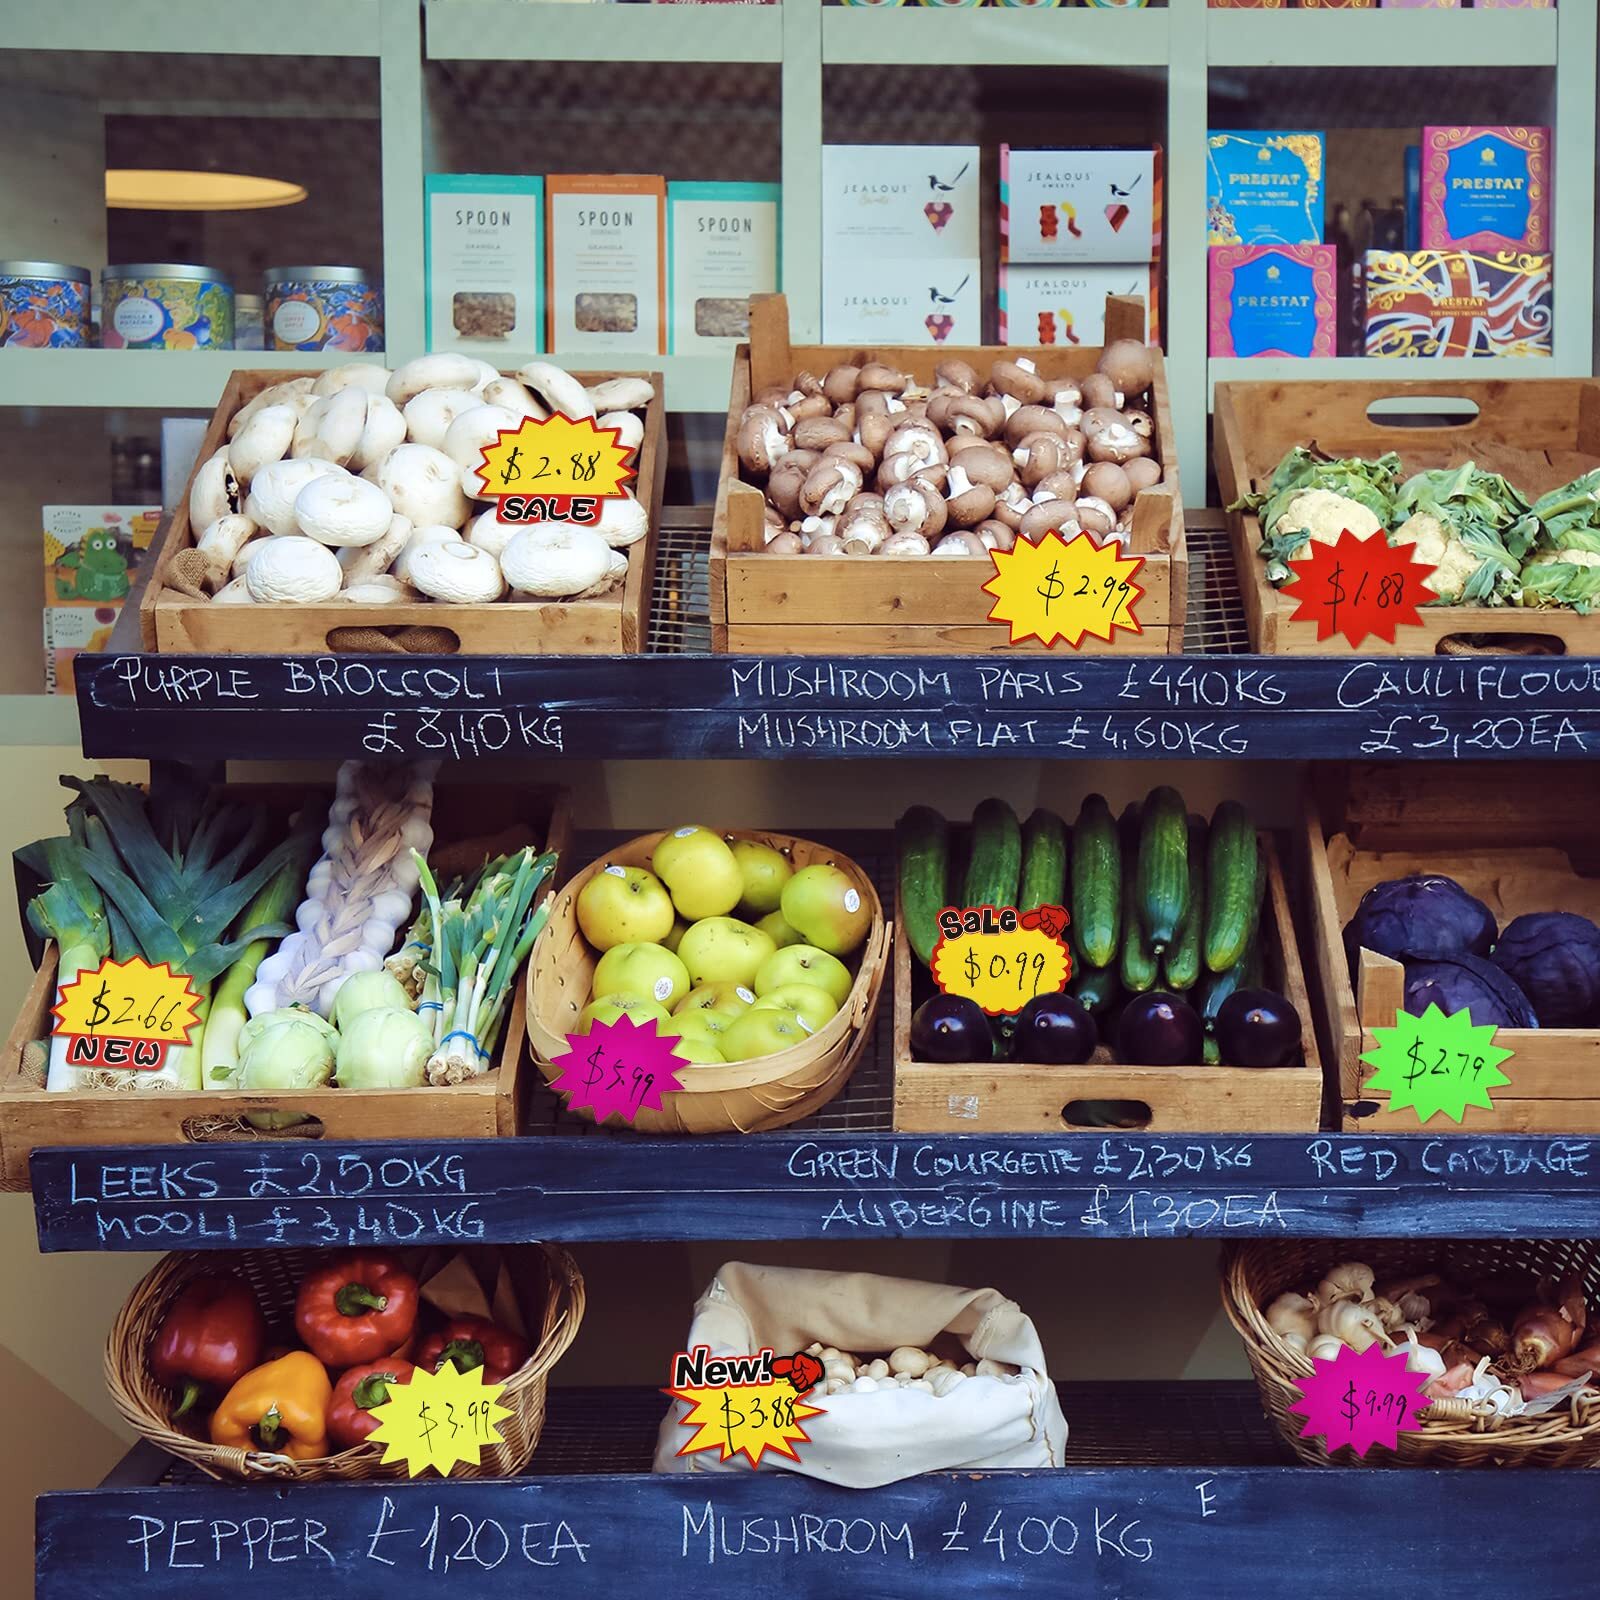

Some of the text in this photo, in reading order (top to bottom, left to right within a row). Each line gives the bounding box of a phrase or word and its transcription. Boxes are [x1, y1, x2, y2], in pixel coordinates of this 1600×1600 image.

[843, 184, 908, 194] JEALOUS
[1027, 172, 1091, 182] JEALOUS
[1229, 173, 1301, 186] PRESTAT
[1452, 177, 1524, 190] PRESTAT
[455, 209, 511, 226] SPOON
[577, 210, 633, 227] SPOON
[697, 216, 752, 233] SPOON
[843, 296, 908, 306] JEALOUS
[1025, 279, 1088, 289] JEALOUS
[1238, 295, 1310, 308] PRESTAT
[1433, 297, 1485, 307] PRESTAT
[502, 497, 597, 521] SALE
[1036, 559, 1131, 622] $2.99
[1322, 561, 1405, 635] $1.88
[112, 656, 506, 704] PURPLE BROCCOLI
[731, 660, 952, 701] MUSHROOM
[975, 666, 1084, 702] PARIS
[737, 713, 934, 751] MUSHROOM
[947, 717, 1040, 749] FLAT
[964, 946, 1046, 998] $0.99
[85, 979, 182, 1041] $2.66
[73, 1037, 161, 1067] NEW
[1401, 1035, 1486, 1090] $2.79
[581, 1044, 656, 1106] $5.99
[786, 1146, 898, 1184] GREEN
[912, 1149, 1085, 1181] COURGETTE
[1305, 1138, 1592, 1181] RED CABBAGE
[71, 1159, 220, 1207] LEEKS
[95, 1206, 238, 1243] MOOLI
[821, 1196, 1068, 1237] AUBERGINE
[675, 1349, 773, 1387] New!
[719, 1391, 801, 1457] $3.88
[1340, 1379, 1408, 1432] $9.99
[418, 1399, 491, 1454] $3.99
[1194, 1479, 1218, 1519] E
[126, 1513, 338, 1574] PEPPER
[681, 1499, 920, 1566] MUSHROOM
